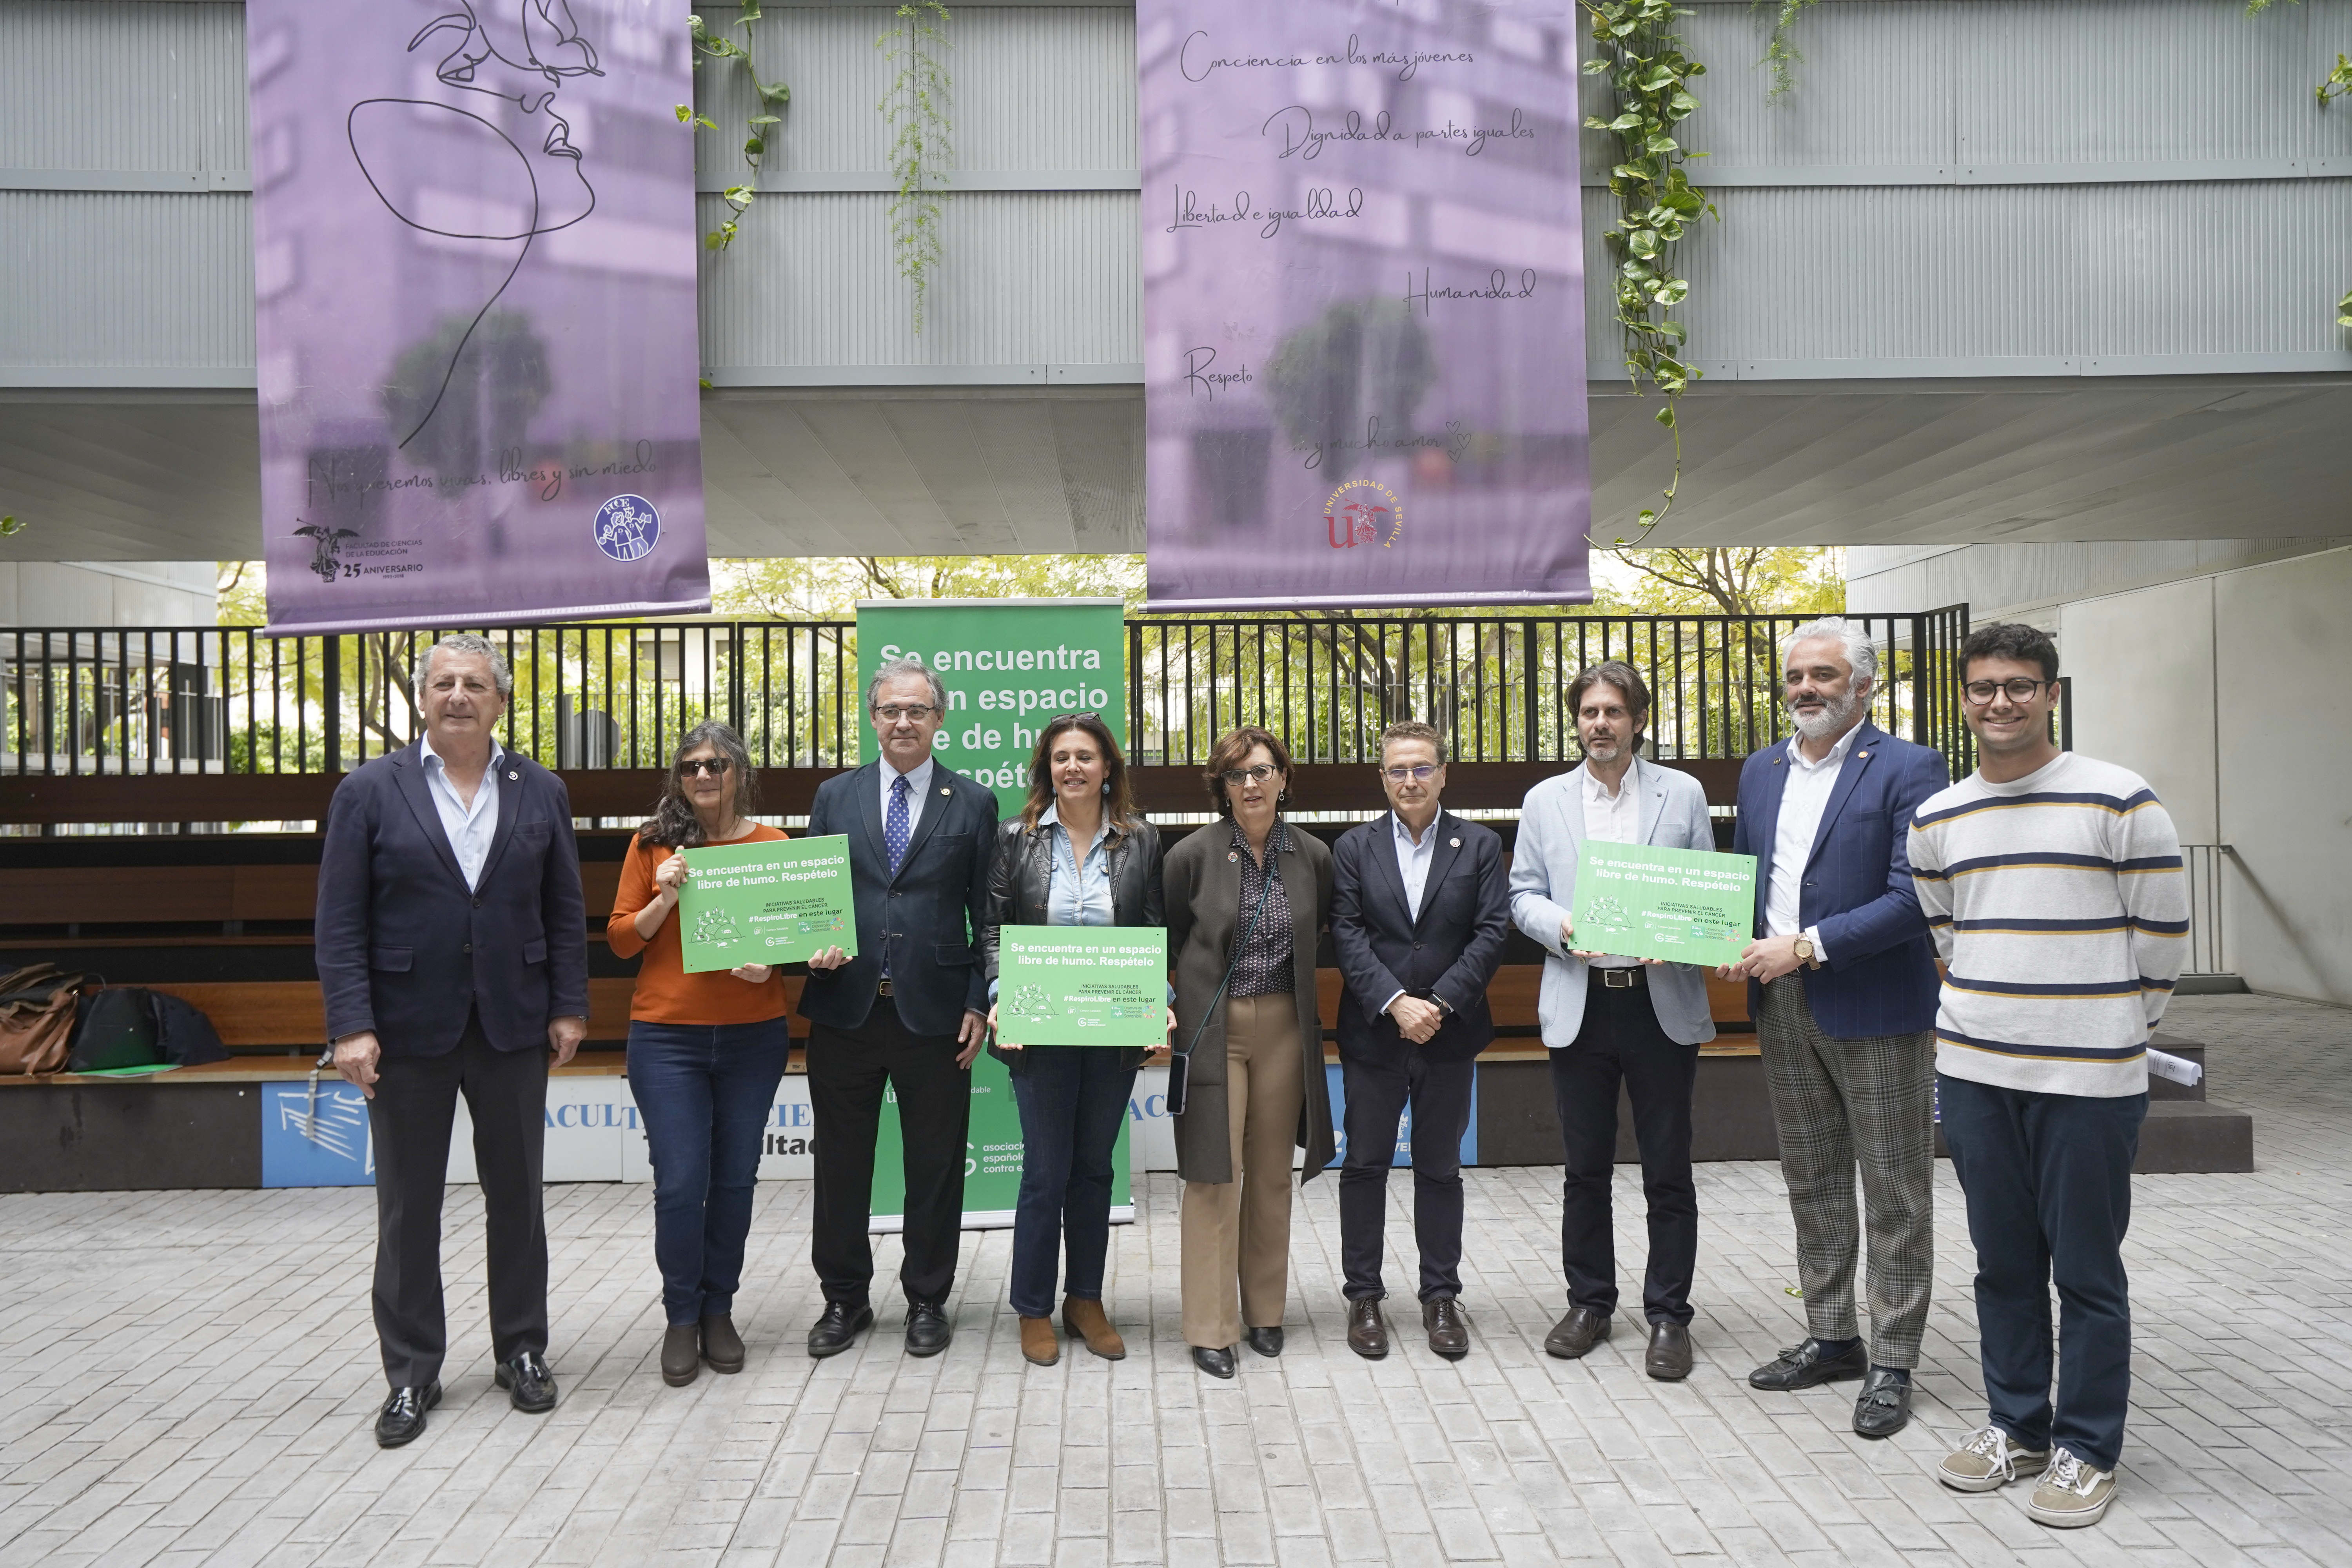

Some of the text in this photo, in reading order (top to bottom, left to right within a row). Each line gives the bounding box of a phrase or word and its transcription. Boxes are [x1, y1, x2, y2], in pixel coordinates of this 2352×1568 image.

[1180, 30, 1474, 82] Conciencia en los más jóvenes
[1262, 106, 1534, 160] Dignidad a partes iguales
[1166, 183, 1363, 239] Libertad e igualdad
[1403, 267, 1536, 317] Humanidad
[1183, 347, 1252, 402] Respeto
[1330, 416, 1389, 450] mucho
[1395, 435, 1442, 448] amor
[355, 474, 433, 510] queremos
[500, 446, 546, 484] libres
[541, 470, 561, 502] y
[569, 464, 598, 479] sin
[602, 439, 656, 475] miedo
[1323, 479, 1403, 548] UNIVERSIDAD DE SEVILLA
[365, 548, 408, 556] EDUCACIÓN
[343, 563, 423, 578] 25 ANIVERSARIO
[933, 644, 1100, 671] encuentra
[948, 682, 1109, 716] n espacio
[962, 723, 1001, 750] de
[688, 855, 845, 878] Se encuentra en un espacio
[697, 869, 838, 890] libre de humo. Respételo
[1590, 856, 1750, 882] Se encuentra en un espacio
[1596, 868, 1741, 892] libre de humo. Respételo
[748, 912, 797, 923] #RespiroLibre
[1641, 910, 1692, 922] #RespiroLibre
[1722, 919, 1741, 927] lugar
[1011, 942, 1161, 956] Se encuentra en un espacio
[1018, 955, 1154, 968] libre de humo. Respételo
[983, 1142, 1024, 1151] asociaci
[983, 1164, 1014, 1173] contra
